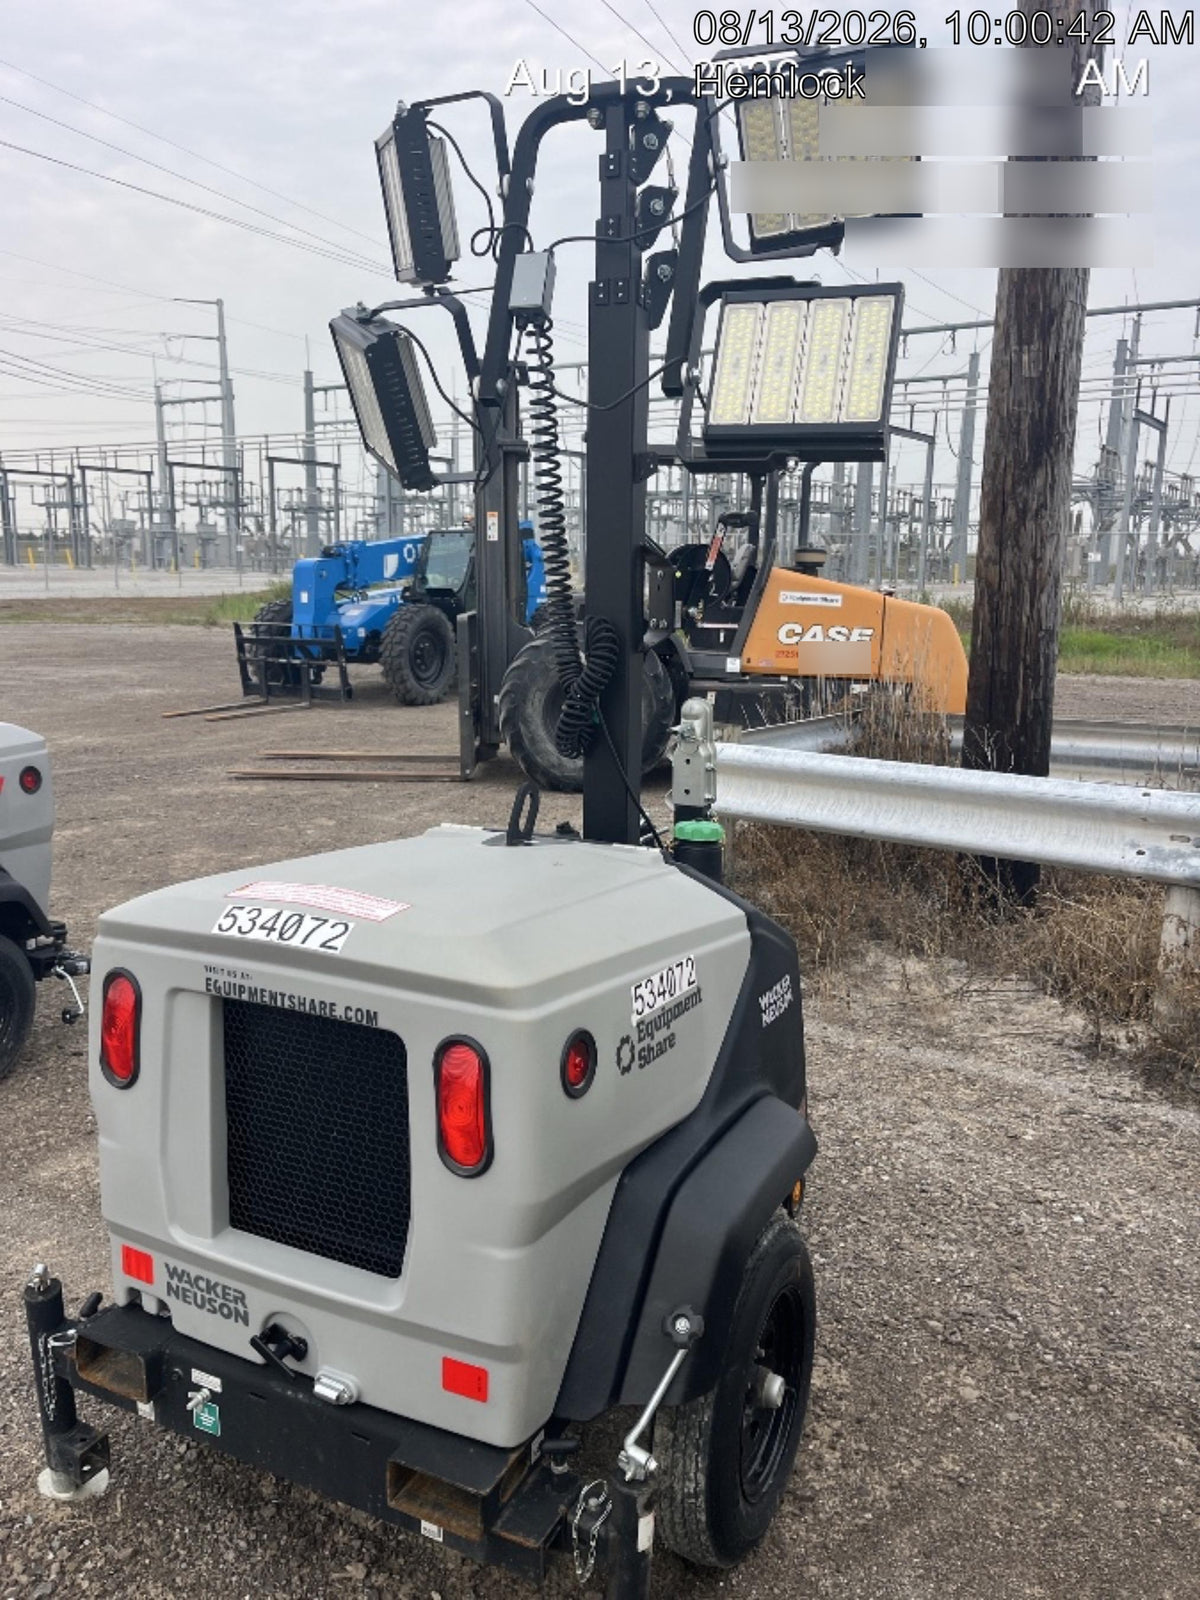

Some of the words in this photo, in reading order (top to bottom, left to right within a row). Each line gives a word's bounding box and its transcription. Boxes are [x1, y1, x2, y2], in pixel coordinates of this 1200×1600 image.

[777, 622, 874, 645] CASE
[217, 905, 350, 951] 534072
[205, 977, 379, 1027] EQUIPMENTSHARE.COM
[633, 957, 696, 1016] 534072
[636, 986, 703, 1044] Equipment
[638, 1031, 676, 1070] Share
[164, 1262, 248, 1310] WACKER
[166, 1281, 249, 1327] NEUSON
